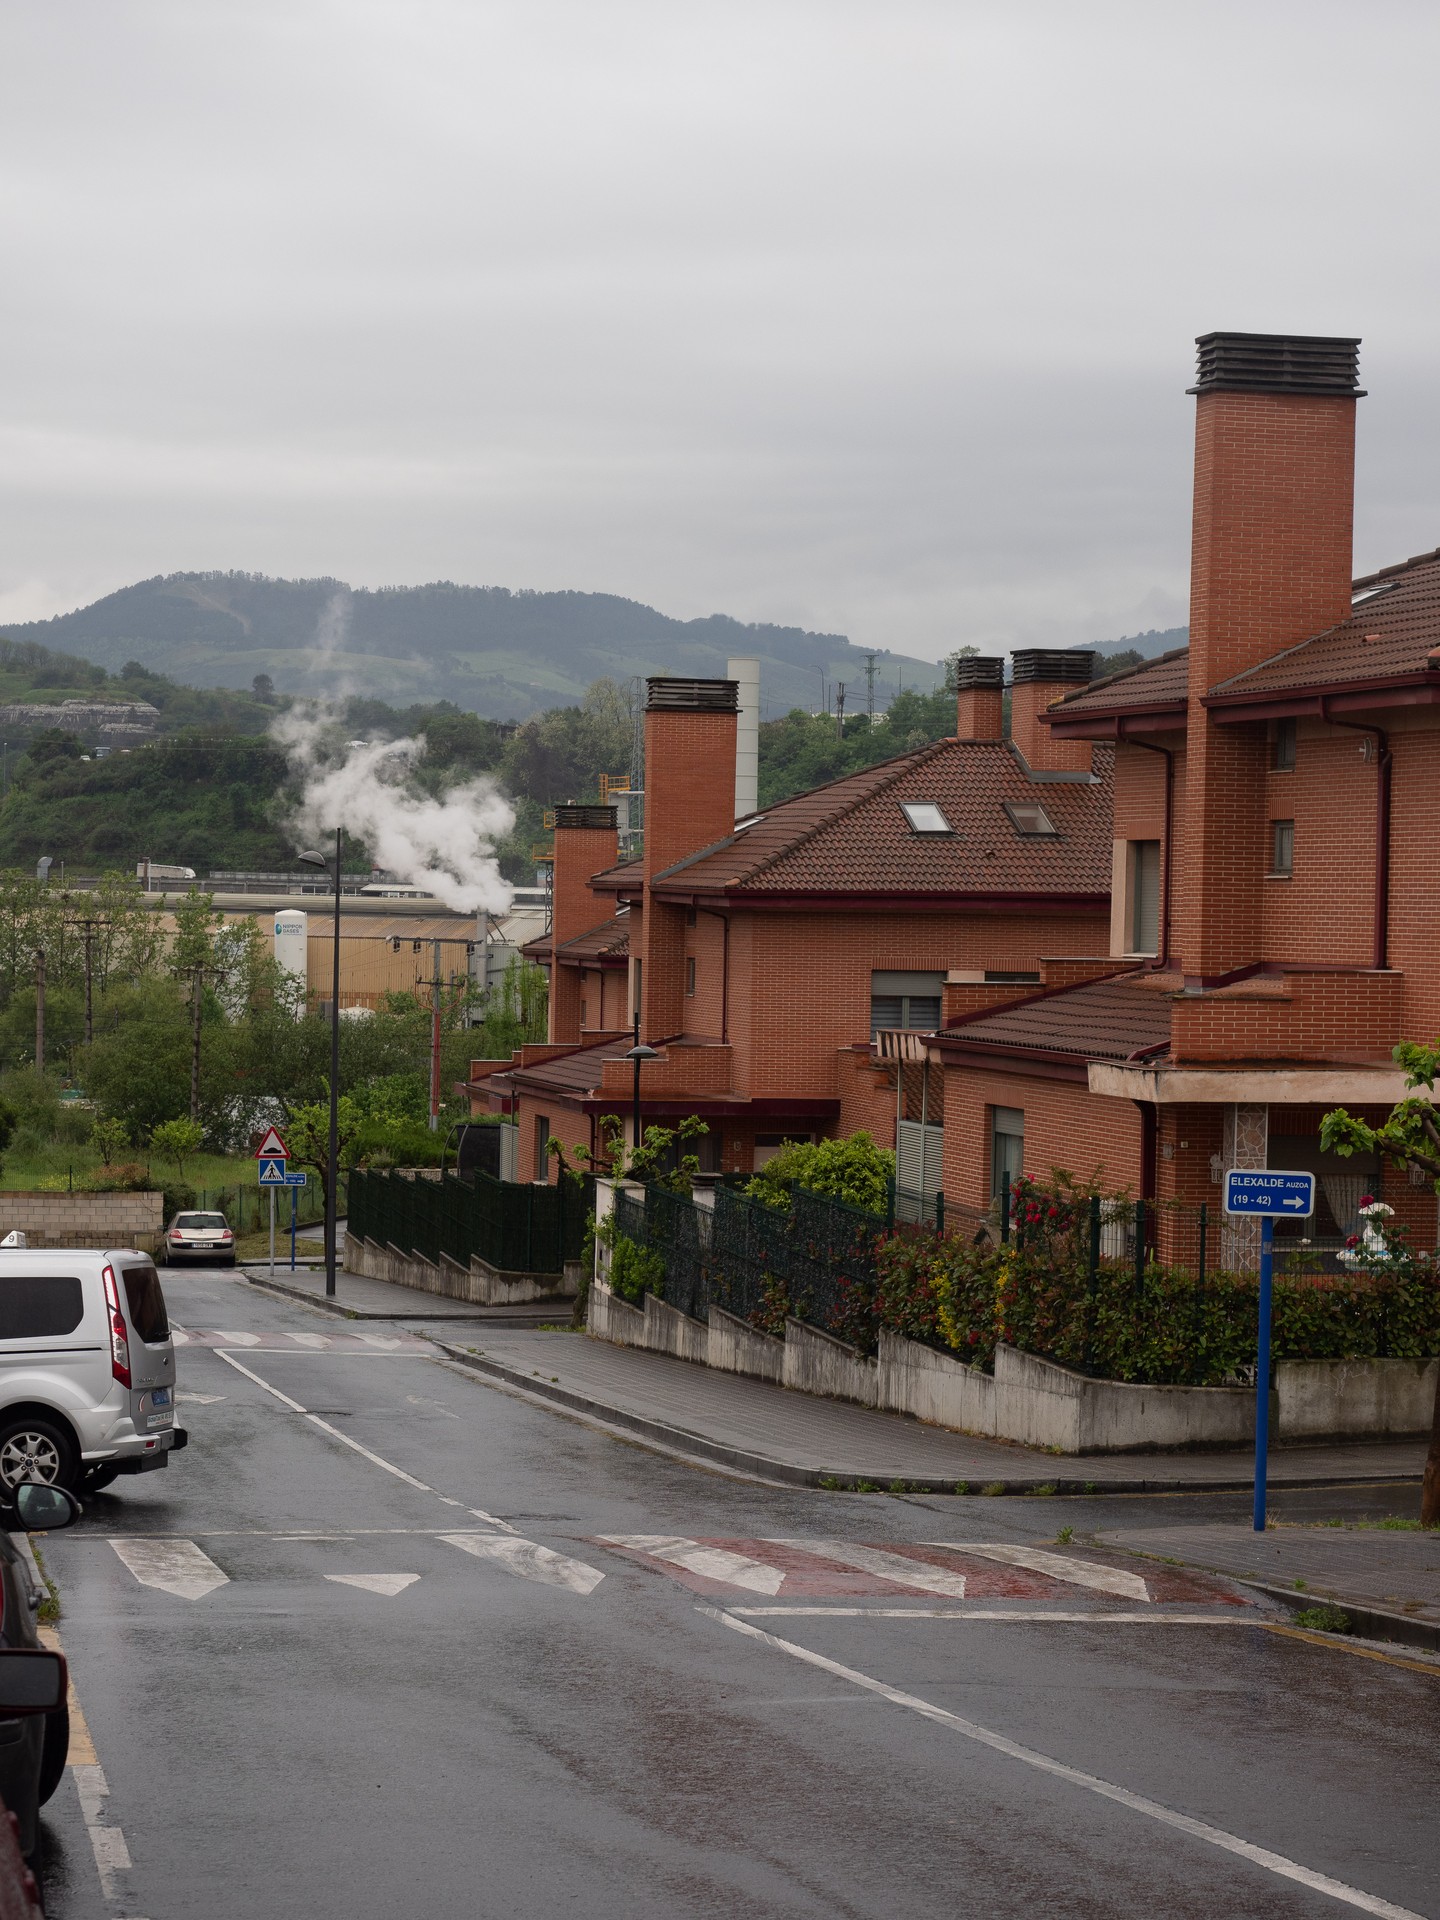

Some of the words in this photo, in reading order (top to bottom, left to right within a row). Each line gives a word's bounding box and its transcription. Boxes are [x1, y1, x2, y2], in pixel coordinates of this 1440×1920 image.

[1231, 1177, 1284, 1188] ELEXALDE
[1233, 1194, 1248, 1205] (19
[1256, 1196, 1272, 1206] 42)
[8, 1234, 14, 1242] 9
